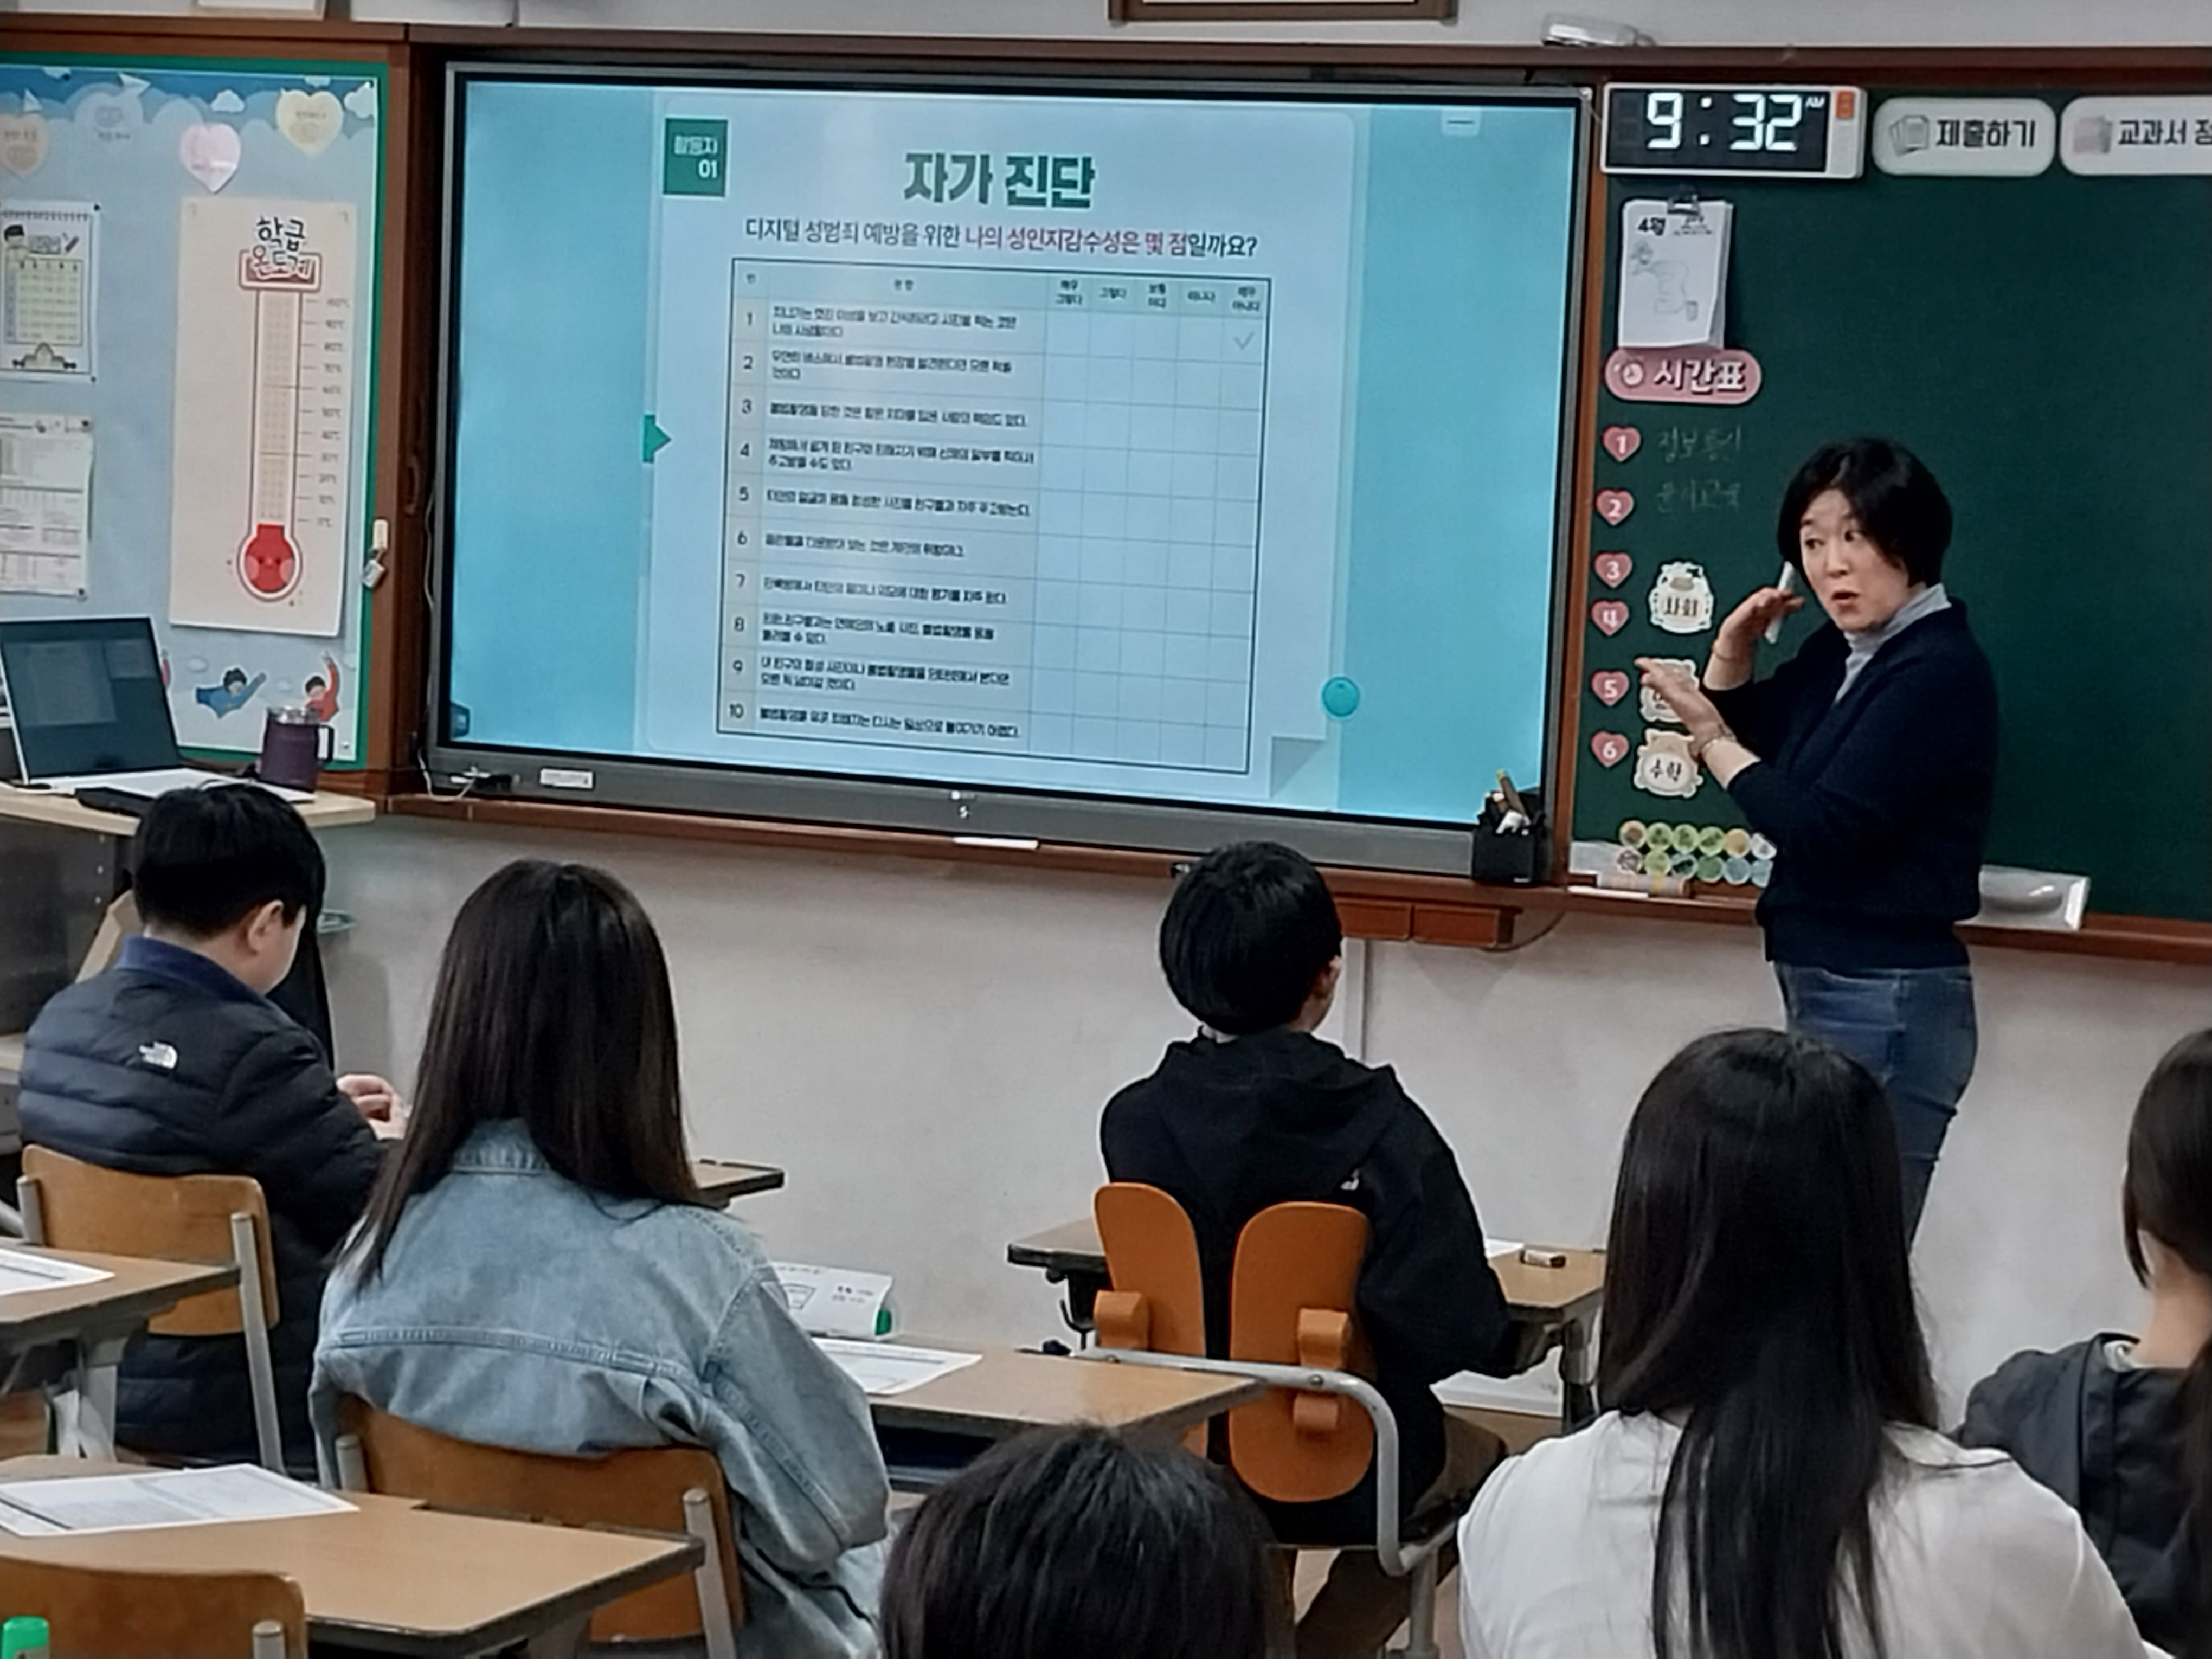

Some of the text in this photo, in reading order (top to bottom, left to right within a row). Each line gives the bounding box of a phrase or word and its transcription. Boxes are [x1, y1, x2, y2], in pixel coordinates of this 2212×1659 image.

[1935, 118, 2036, 148] 제출하기
[2118, 118, 2187, 145] 교과서
[698, 159, 718, 179] 01
[904, 152, 1096, 209] 자가 진단
[256, 216, 305, 252] 학급
[745, 217, 1258, 259] 디지털 성범죄 예방을 위한 나의 성인지감수성은 몇 점일까요?
[747, 312, 753, 326] 1
[743, 356, 754, 370] 2
[1654, 358, 1745, 395] 시간표
[742, 399, 752, 414] 3
[740, 443, 750, 457] 4
[1616, 434, 1626, 454] 1
[739, 486, 749, 501] 5
[1608, 499, 1622, 516] 2
[737, 531, 748, 545] 6
[1606, 561, 1620, 580] 3
[736, 574, 745, 588] 7
[734, 616, 745, 632] 8
[732, 660, 743, 674] 9
[1604, 679, 1618, 698] 5
[729, 704, 744, 719] 10
[1603, 741, 1617, 759] 6
